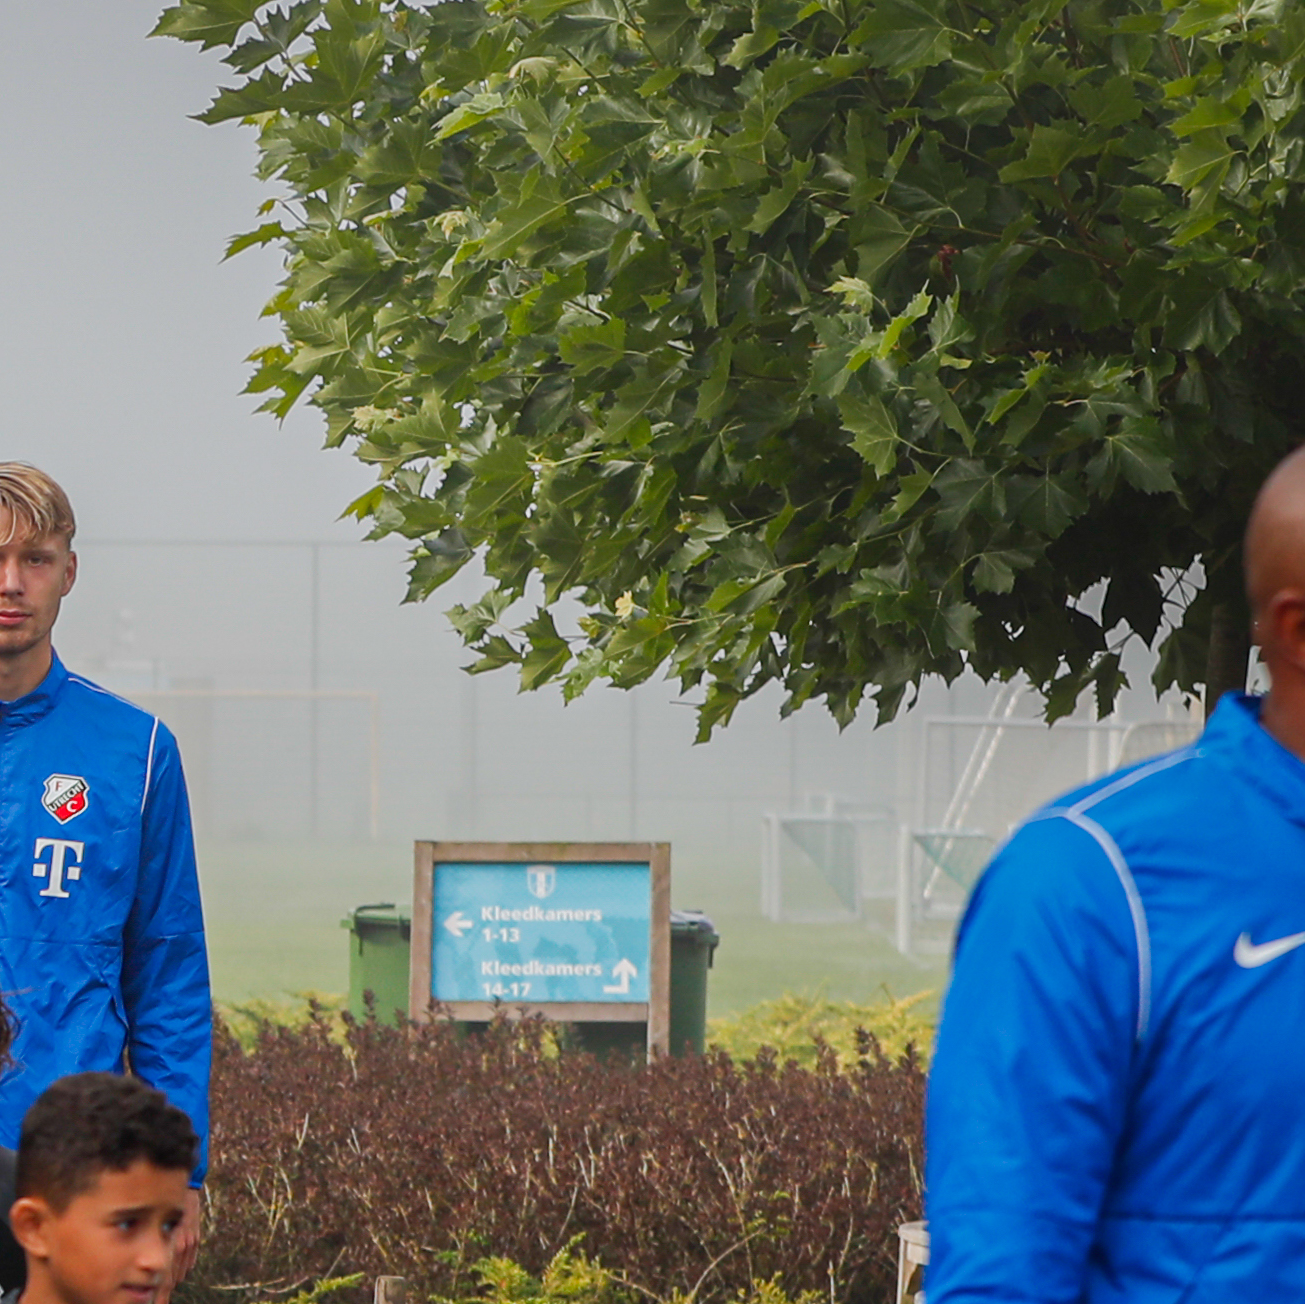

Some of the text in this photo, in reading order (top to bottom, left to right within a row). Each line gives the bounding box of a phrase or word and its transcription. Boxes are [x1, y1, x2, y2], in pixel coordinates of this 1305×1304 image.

[33, 838, 84, 898] T
[481, 905, 602, 921] Kleedkamers
[482, 927, 521, 943] 1-13
[481, 960, 602, 976] Kleedkamers
[482, 981, 532, 998] 14-17
